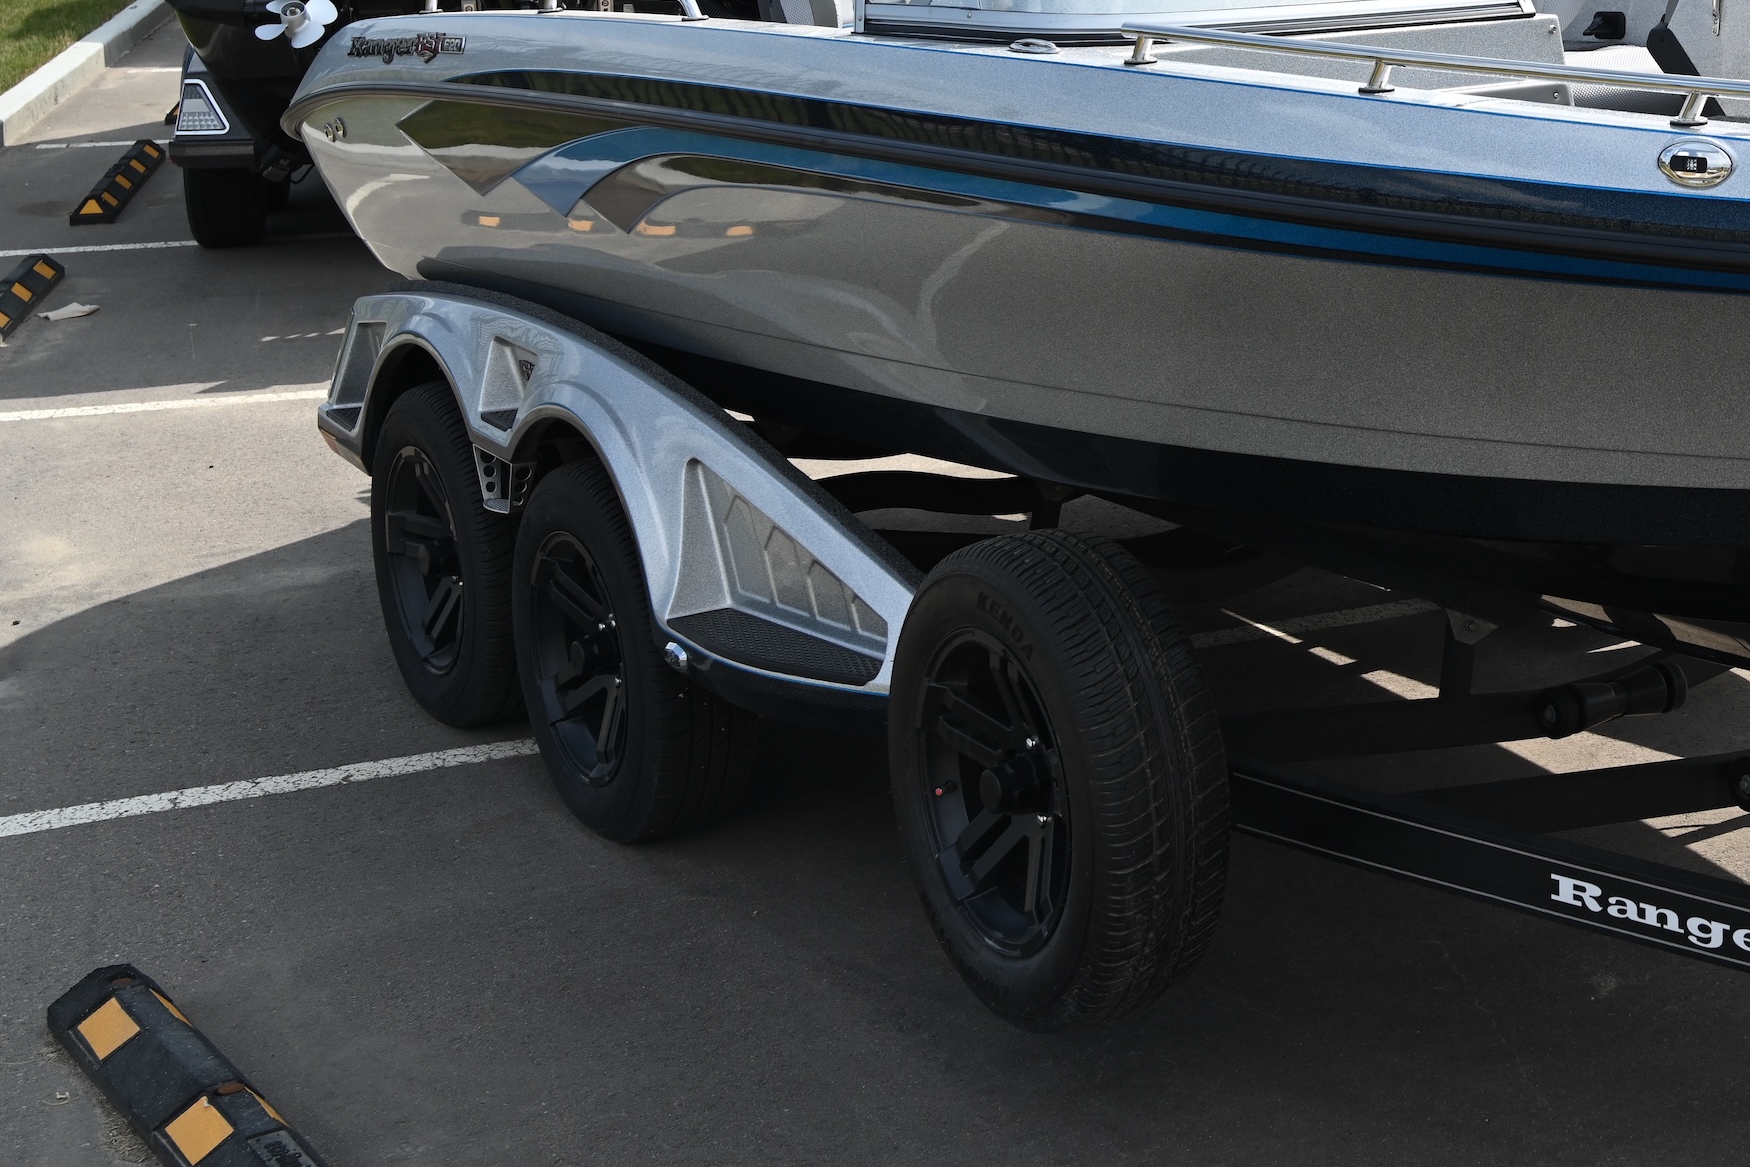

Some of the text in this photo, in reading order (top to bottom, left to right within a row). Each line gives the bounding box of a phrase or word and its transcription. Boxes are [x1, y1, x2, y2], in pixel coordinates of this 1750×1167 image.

[347, 36, 417, 65] Ranger
[443, 39, 461, 52] 620
[976, 591, 1035, 663] KENDA
